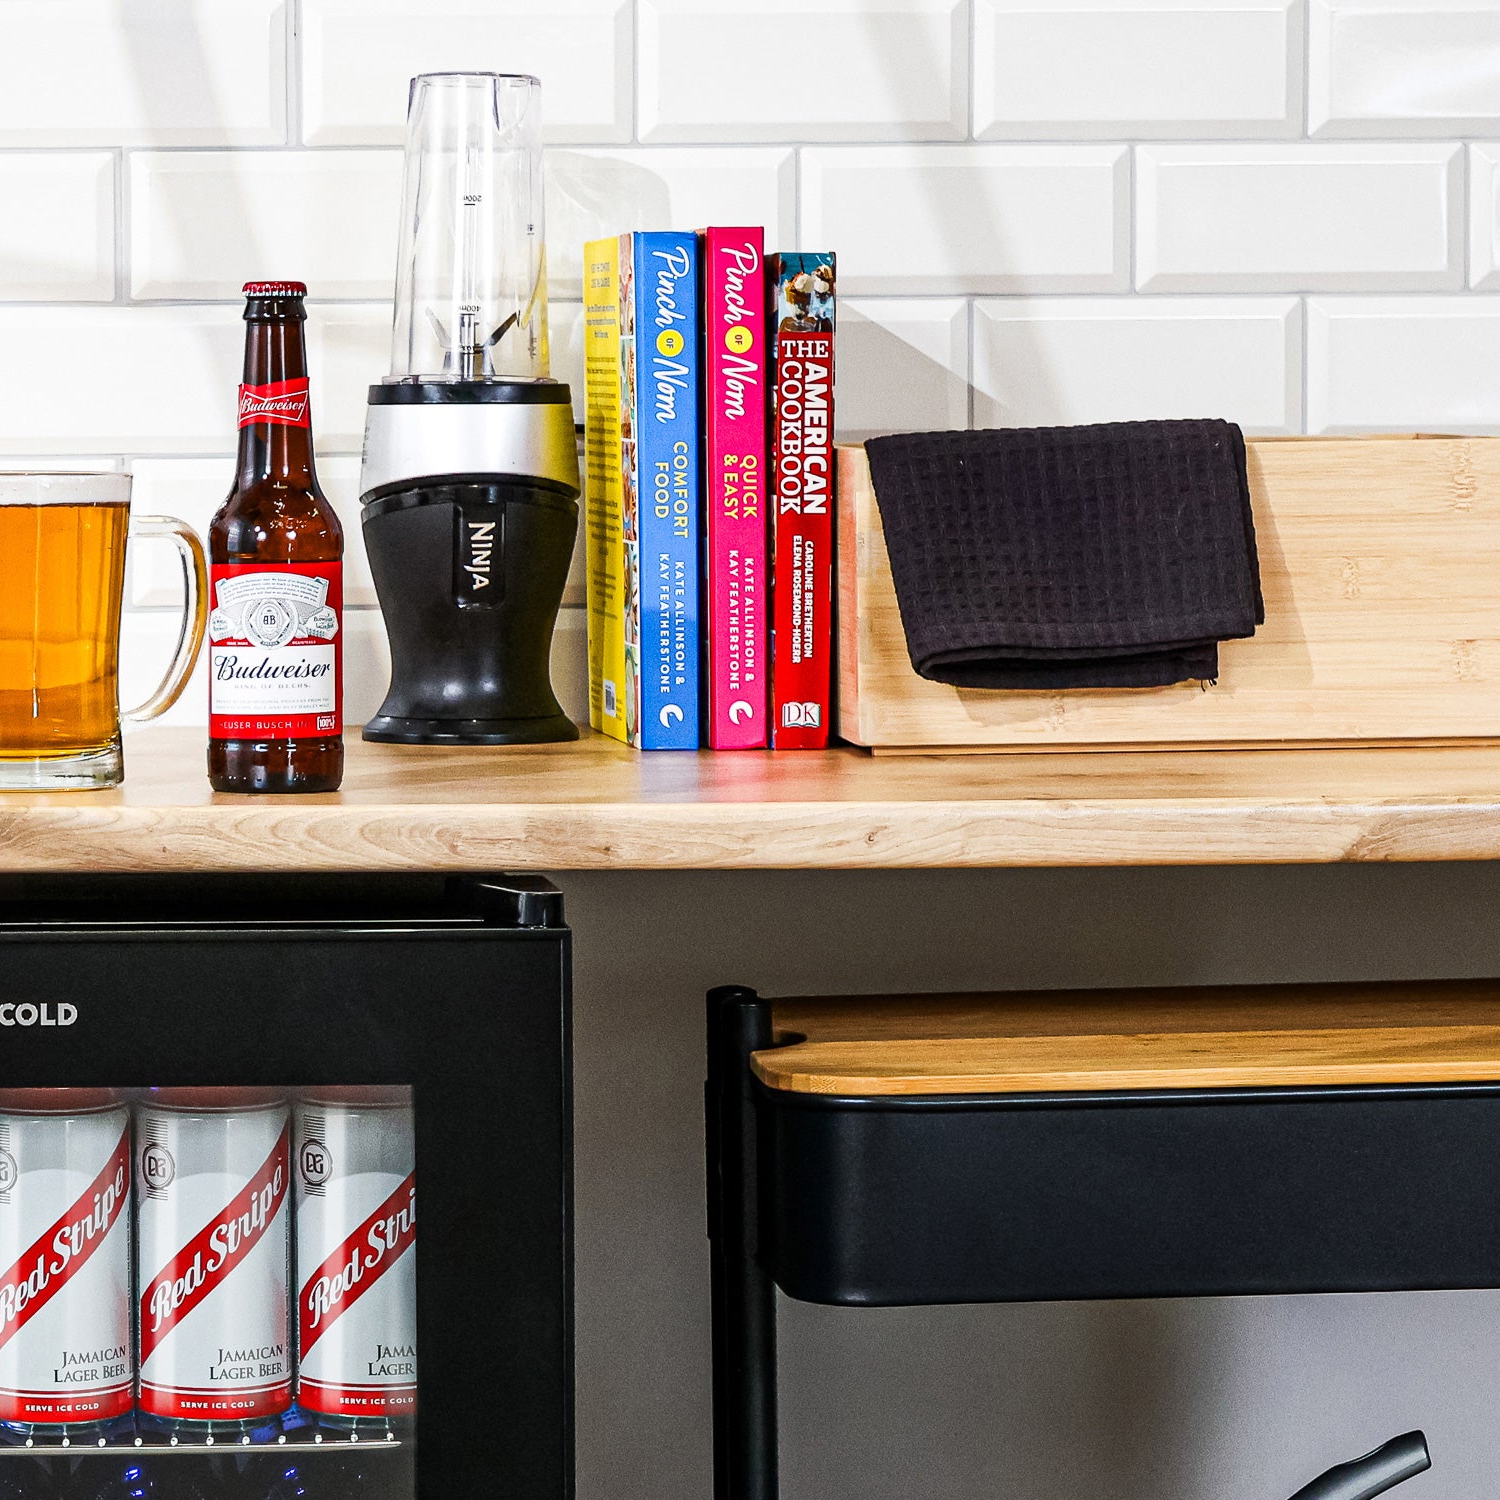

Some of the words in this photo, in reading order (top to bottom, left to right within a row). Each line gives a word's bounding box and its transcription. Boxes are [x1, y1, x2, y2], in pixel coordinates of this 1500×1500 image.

[652, 246, 690, 328] Pinch
[720, 243, 759, 325] Pinch
[666, 337, 674, 349] OF
[734, 334, 743, 345] OF
[781, 340, 829, 358] THE
[652, 357, 690, 424] Nom
[721, 354, 759, 421] Nom
[242, 397, 305, 414] Budweiser
[780, 360, 803, 515] COOKBOOK
[803, 361, 828, 514] AMERICAN
[724, 455, 739, 466] &
[654, 462, 670, 519] FOOD
[673, 441, 689, 538] COMFORT
[724, 469, 739, 520] EASY
[740, 455, 758, 518] QUICK
[463, 521, 496, 591] NINJA
[659, 554, 670, 580] KAY
[729, 550, 739, 577] KAY
[792, 535, 803, 568] ELENA
[804, 541, 814, 590] CAROLINE
[675, 562, 685, 596] KATE
[744, 558, 754, 592] KATE
[792, 570, 803, 664] ROSEMOND-HOERR
[804, 592, 814, 658] BRETHERTON
[659, 585, 670, 693] FEATHERSTONE
[674, 603, 685, 673] ALLINSON
[729, 582, 740, 690] FEATHERSTONE
[744, 600, 755, 670] ALLINSON
[214, 656, 331, 680] Budweiser
[675, 676, 685, 685] &
[744, 672, 754, 681] &
[787, 705, 816, 723] DK
[50, 1166, 125, 1275] Stripe
[150, 1252, 207, 1333] Red
[207, 1163, 283, 1273] Stripe
[308, 1247, 365, 1328] Red
[365, 1187, 416, 1268] Stri
[62, 1345, 127, 1369] JAMAICAN
[218, 1343, 284, 1366] JAMAICAN
[368, 1362, 415, 1376] LAGER
[376, 1344, 416, 1361] JAMA
[54, 1366, 100, 1383] LAGER
[102, 1363, 127, 1380] BEER
[210, 1363, 256, 1381] LAGER
[258, 1361, 283, 1378] BEER
[25, 1404, 54, 1412] SERVE
[75, 1403, 100, 1411] COLD
[180, 1401, 209, 1409] SERVE
[212, 1401, 228, 1409] ICE
[230, 1400, 255, 1408] COLD
[339, 1397, 368, 1405] SERVE
[371, 1397, 386, 1405] ICE
[389, 1396, 414, 1405] COLD
